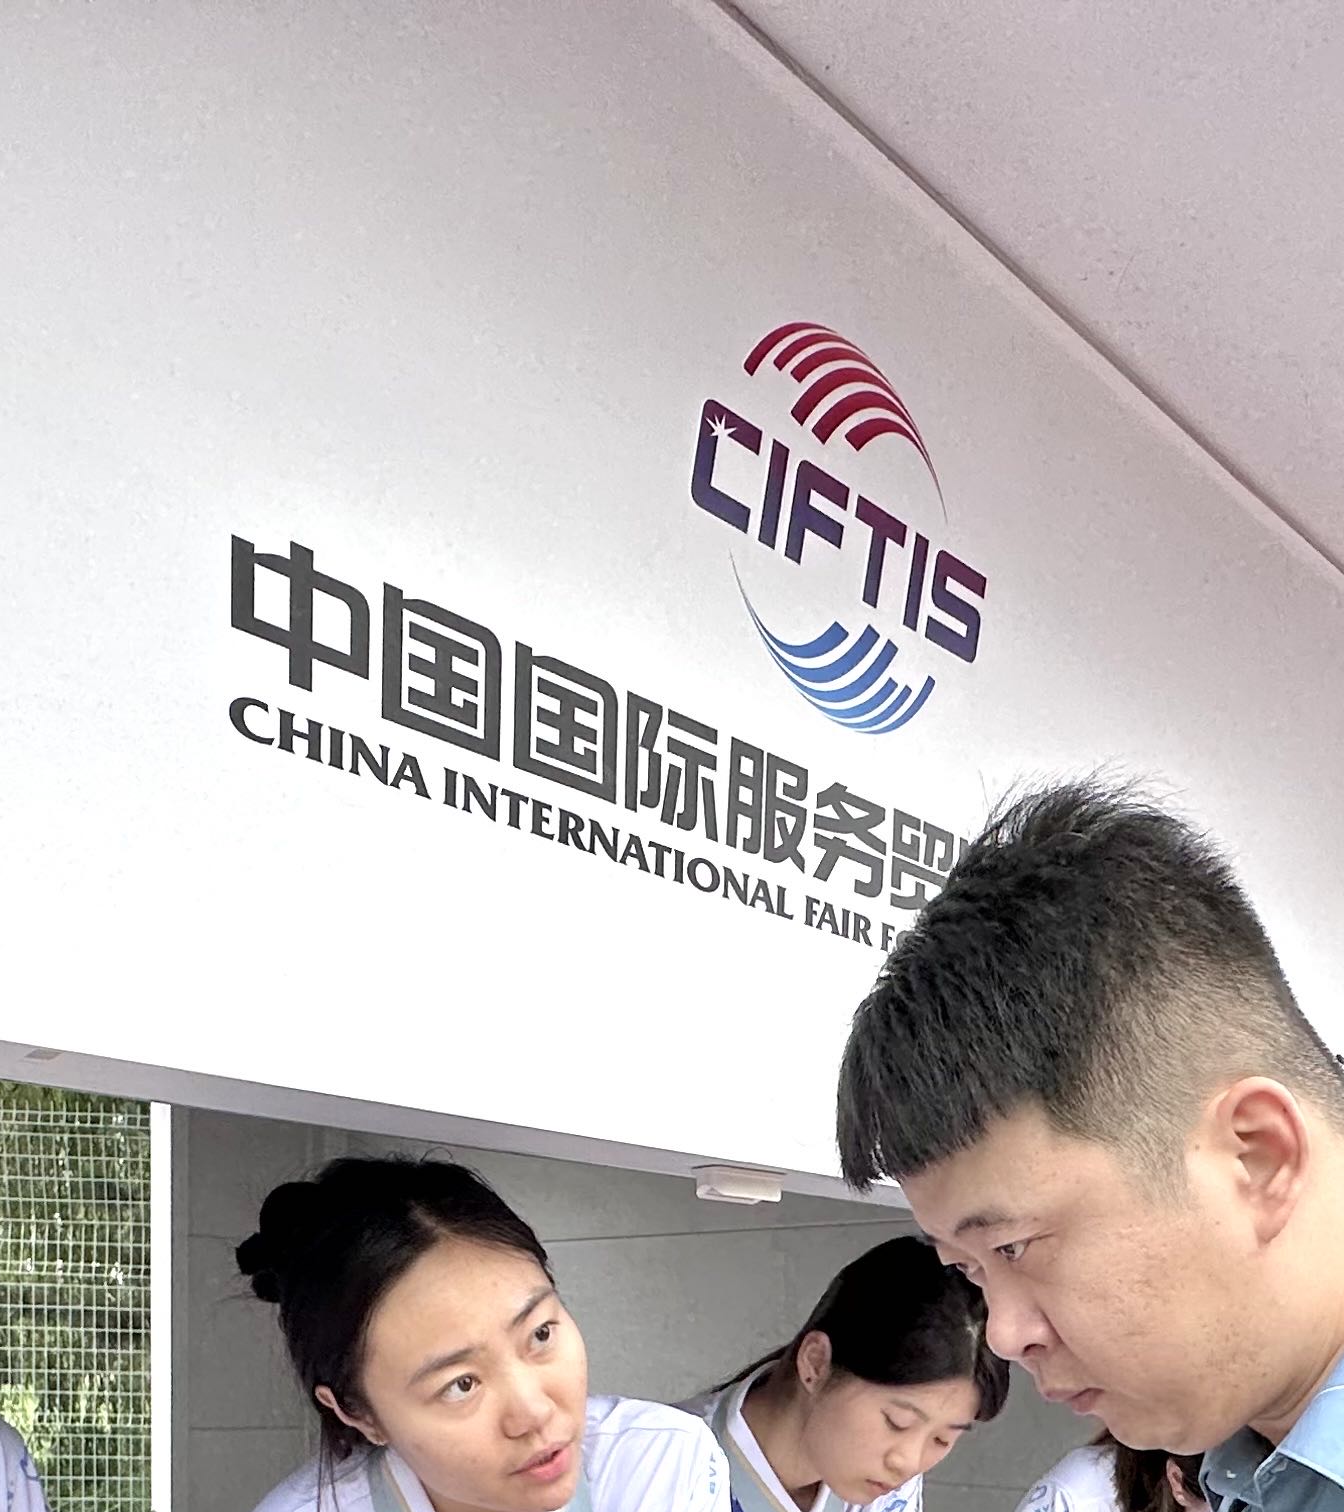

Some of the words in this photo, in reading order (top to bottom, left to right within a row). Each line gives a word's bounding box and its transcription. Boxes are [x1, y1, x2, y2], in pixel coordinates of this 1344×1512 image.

[690, 398, 987, 664] CIFTIS
[229, 696, 432, 800] CHINA
[442, 766, 794, 921] INTERNATIONAL
[803, 894, 873, 947] FAIR
[230, 535, 966, 912] 中国国际服务贸
